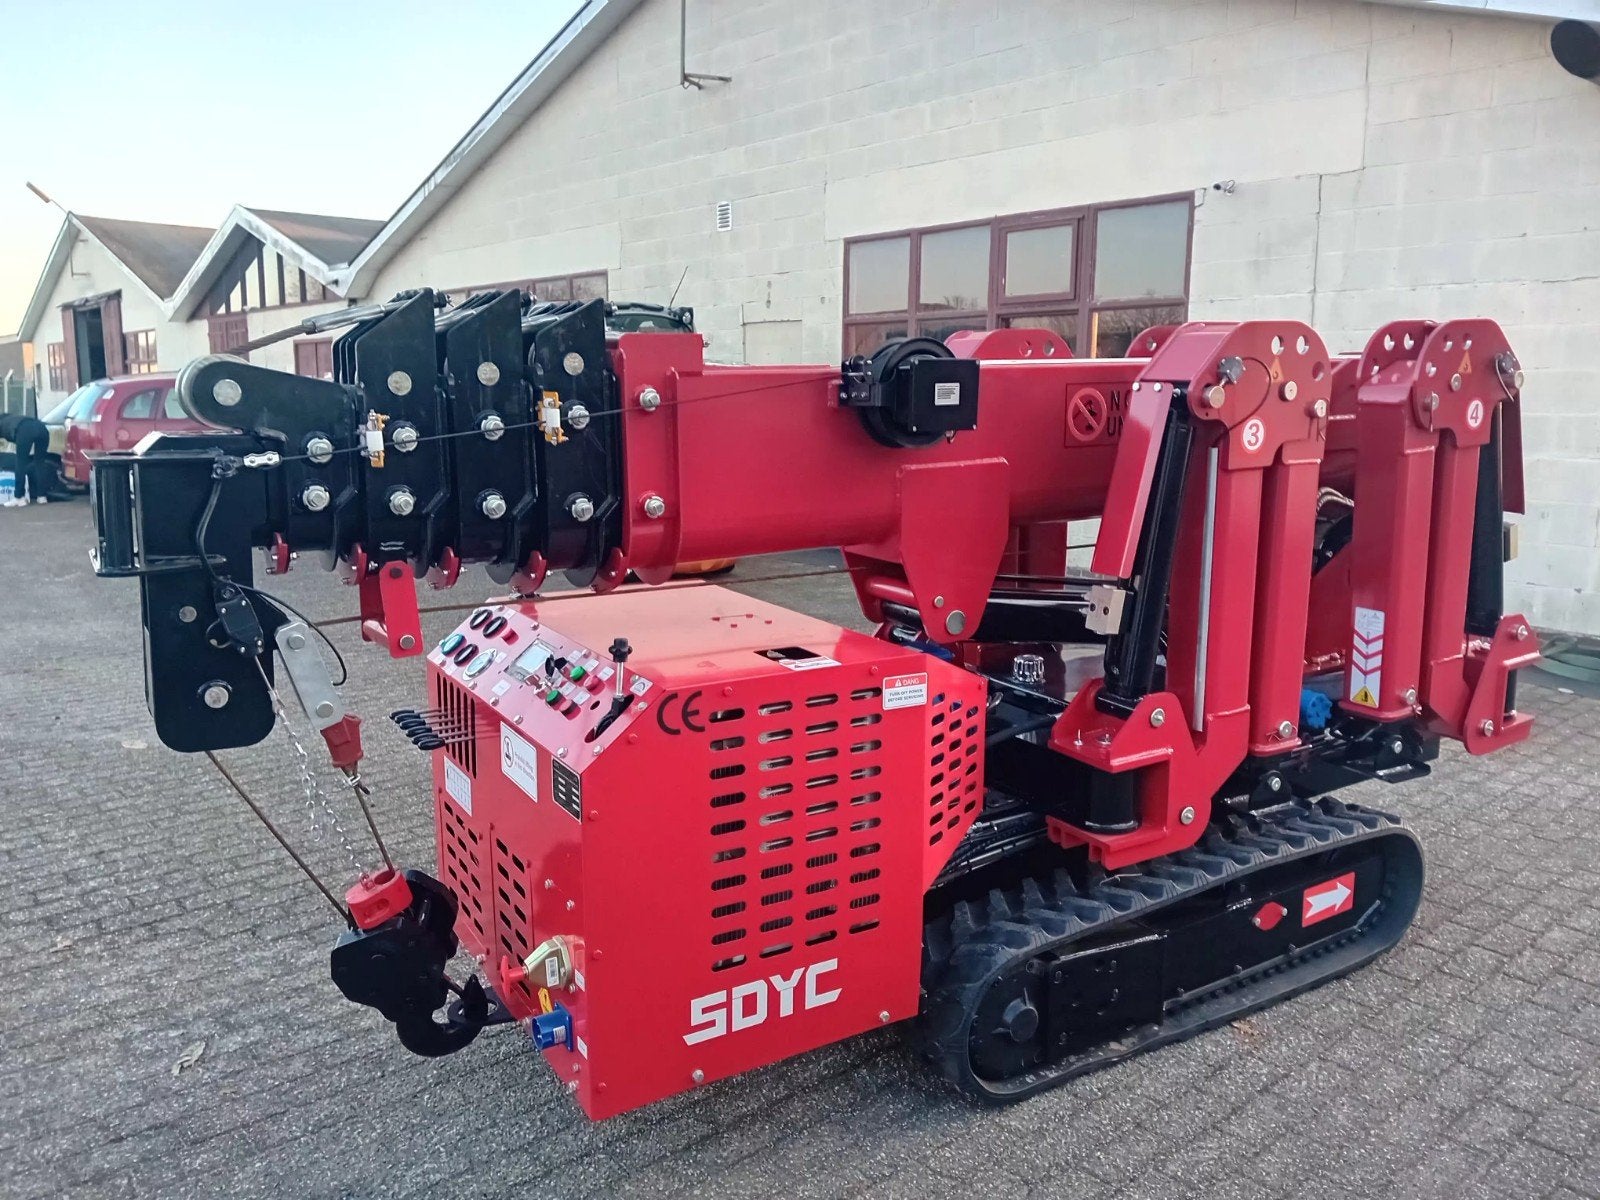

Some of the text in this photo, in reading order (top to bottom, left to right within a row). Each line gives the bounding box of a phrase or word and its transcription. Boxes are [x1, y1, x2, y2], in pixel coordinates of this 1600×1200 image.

[1469, 403, 1480, 424] 4
[1246, 422, 1261, 447] 3
[656, 690, 706, 736] CE
[682, 957, 842, 1047] SDYC
